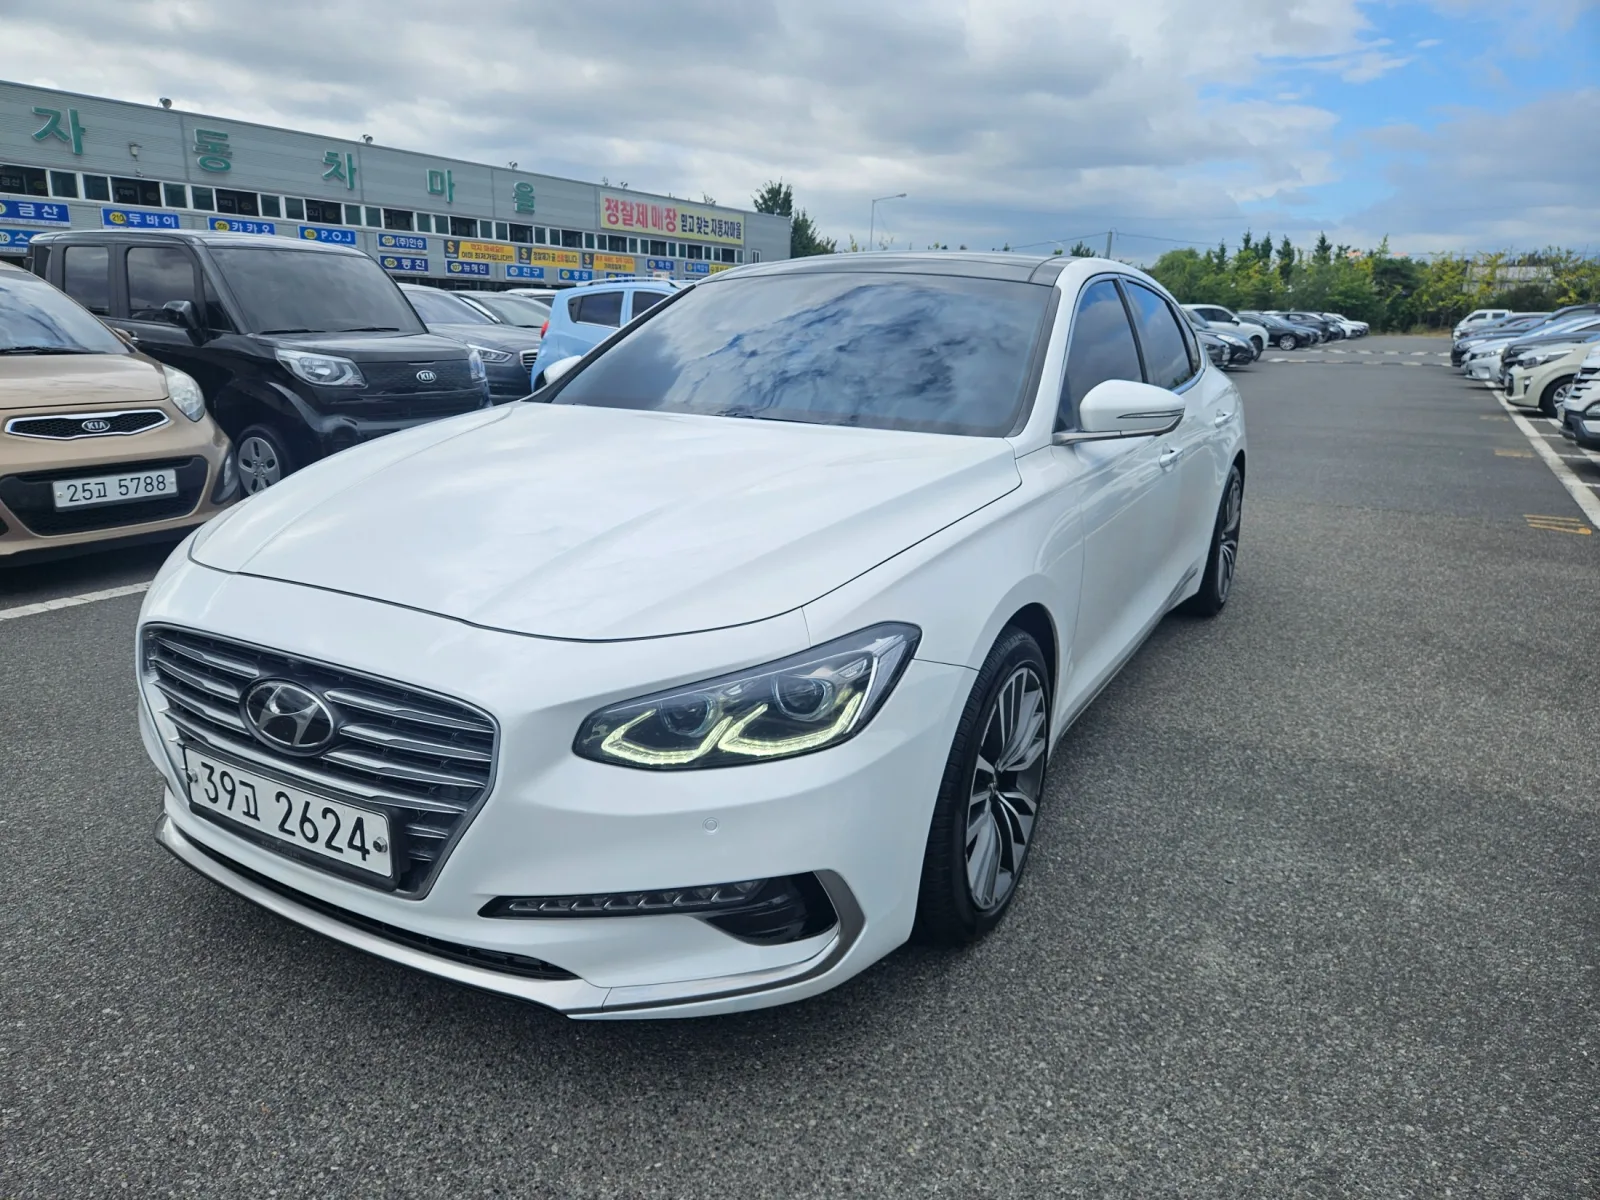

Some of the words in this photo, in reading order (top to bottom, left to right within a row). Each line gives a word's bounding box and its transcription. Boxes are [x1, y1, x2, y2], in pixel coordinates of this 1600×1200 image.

[18, 203, 59, 219] 금산
[604, 197, 649, 229] 정찰제
[651, 203, 678, 233] 매장
[680, 213, 695, 233] 믿고
[710, 218, 742, 240] 자동차마을
[111, 213, 124, 222] 210
[129, 213, 176, 228] 두바이
[231, 221, 270, 235] 카카오
[321, 230, 352, 242] P.O.J
[419, 372, 436, 381] KIA
[85, 421, 107, 430] KIA
[66, 481, 108, 503] 25고
[118, 474, 167, 497] 5788
[199, 760, 261, 823] 39고
[274, 790, 371, 862] 2624
